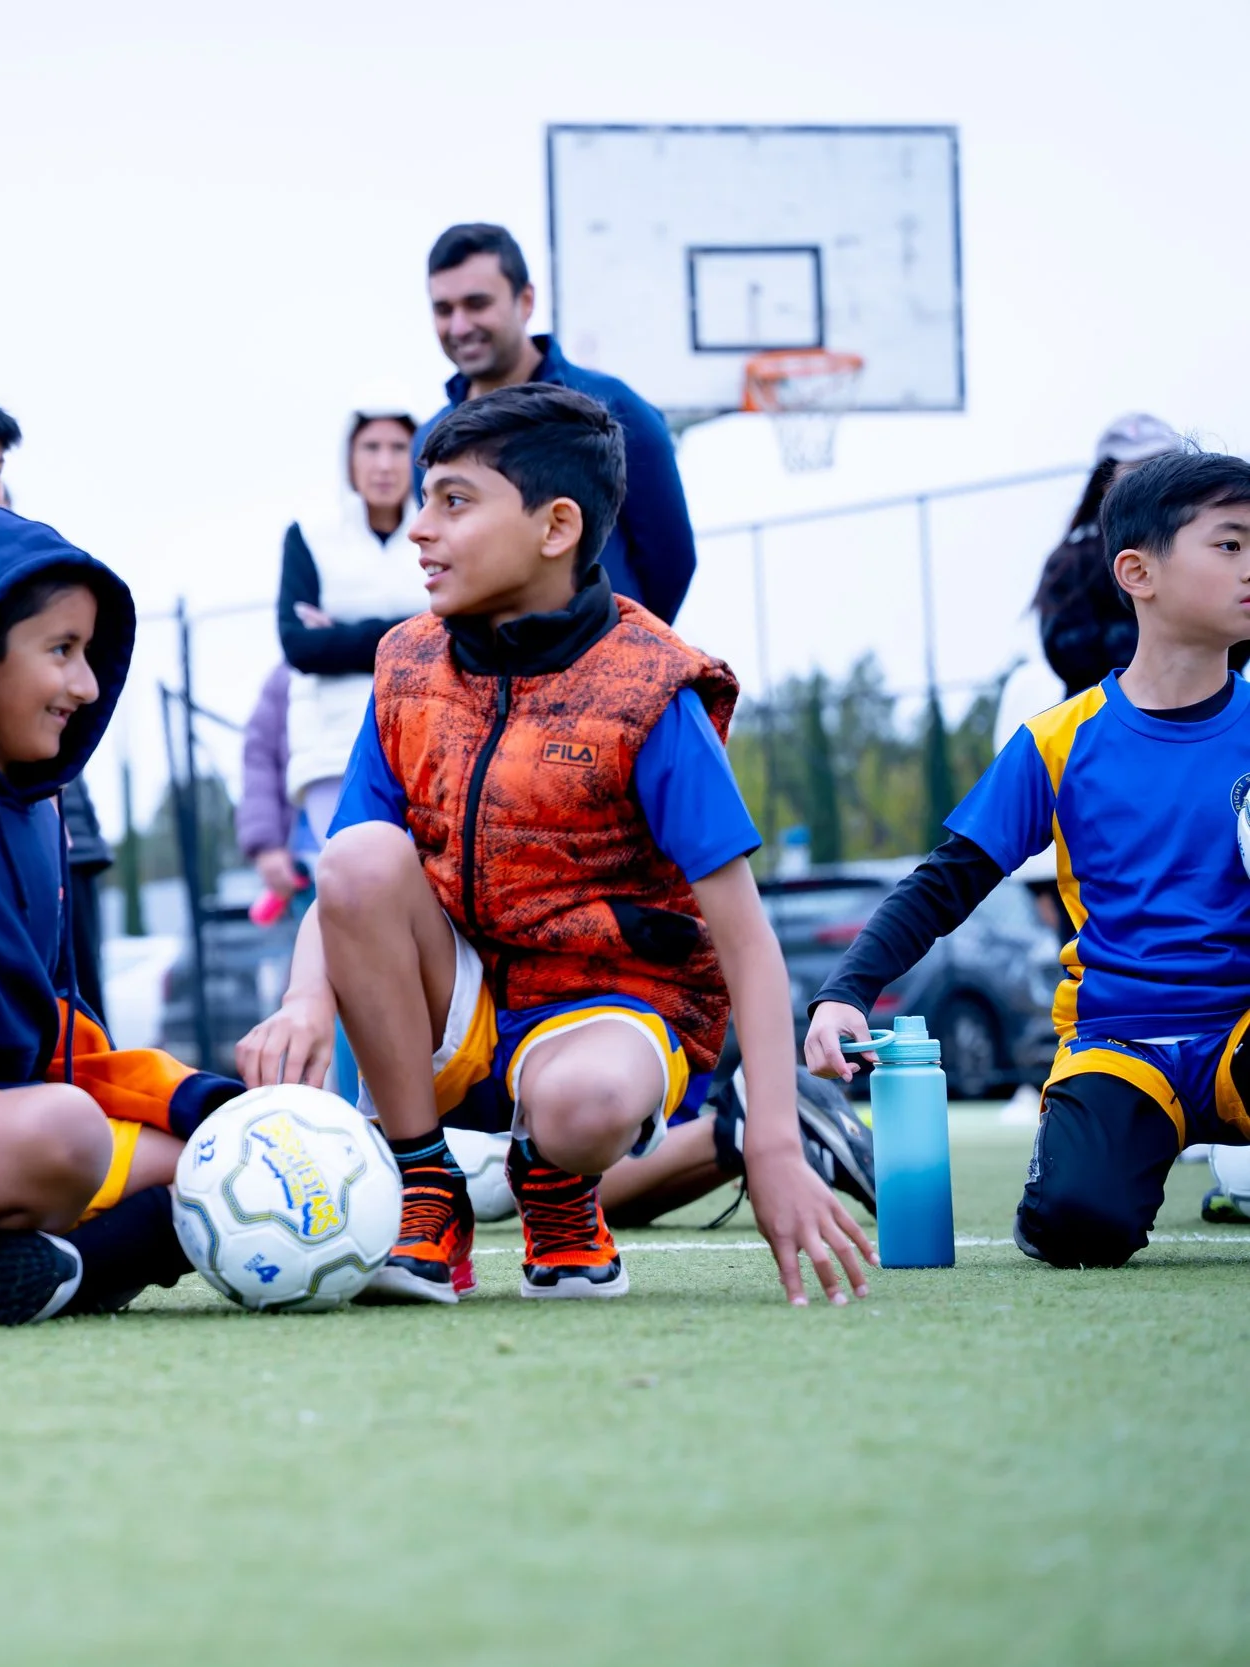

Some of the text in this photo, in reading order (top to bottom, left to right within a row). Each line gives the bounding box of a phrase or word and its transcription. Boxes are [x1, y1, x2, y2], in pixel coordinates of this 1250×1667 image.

[545, 743, 593, 763] FILA
[1234, 782, 1244, 810] RIGHT
[256, 1264, 281, 1283] 4
